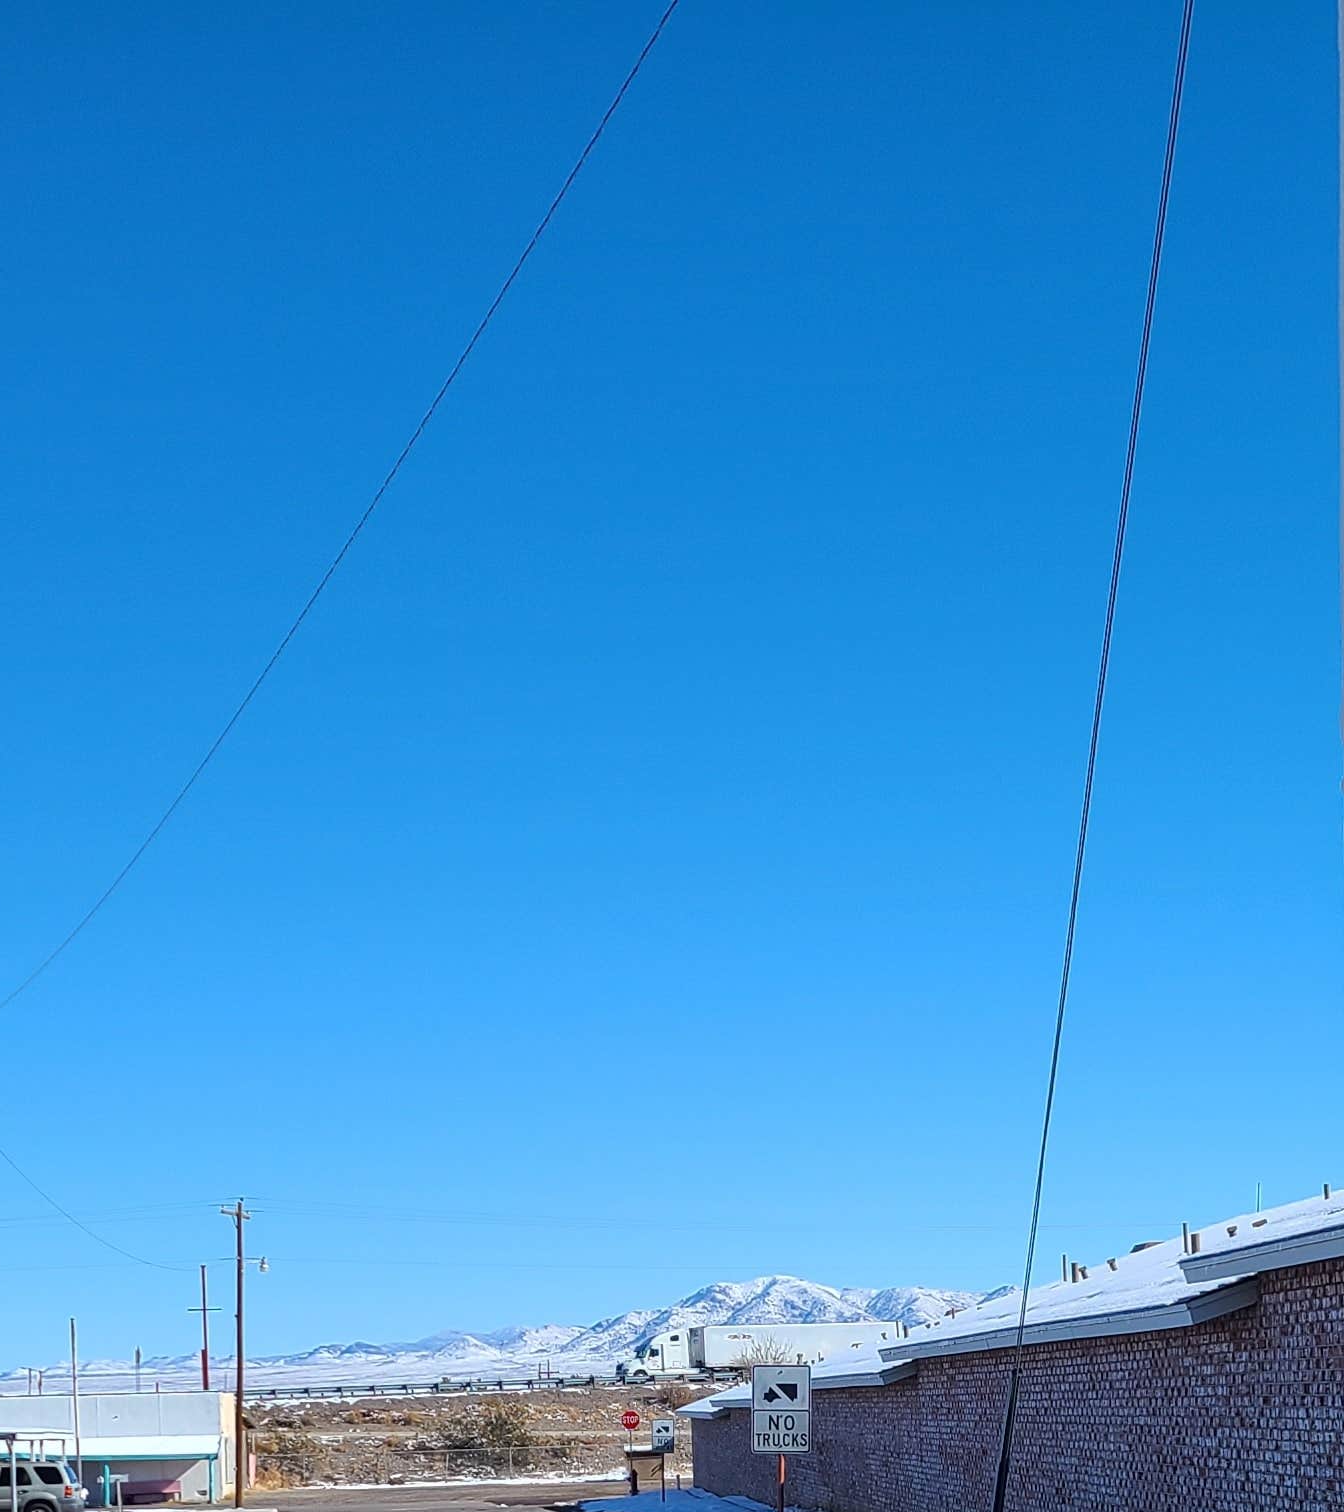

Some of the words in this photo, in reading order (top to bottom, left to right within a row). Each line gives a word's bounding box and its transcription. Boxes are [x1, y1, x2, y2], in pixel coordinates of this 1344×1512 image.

[622, 1415, 639, 1424] STOP
[768, 1415, 795, 1431] NO
[756, 1433, 808, 1448] TRUCKS
